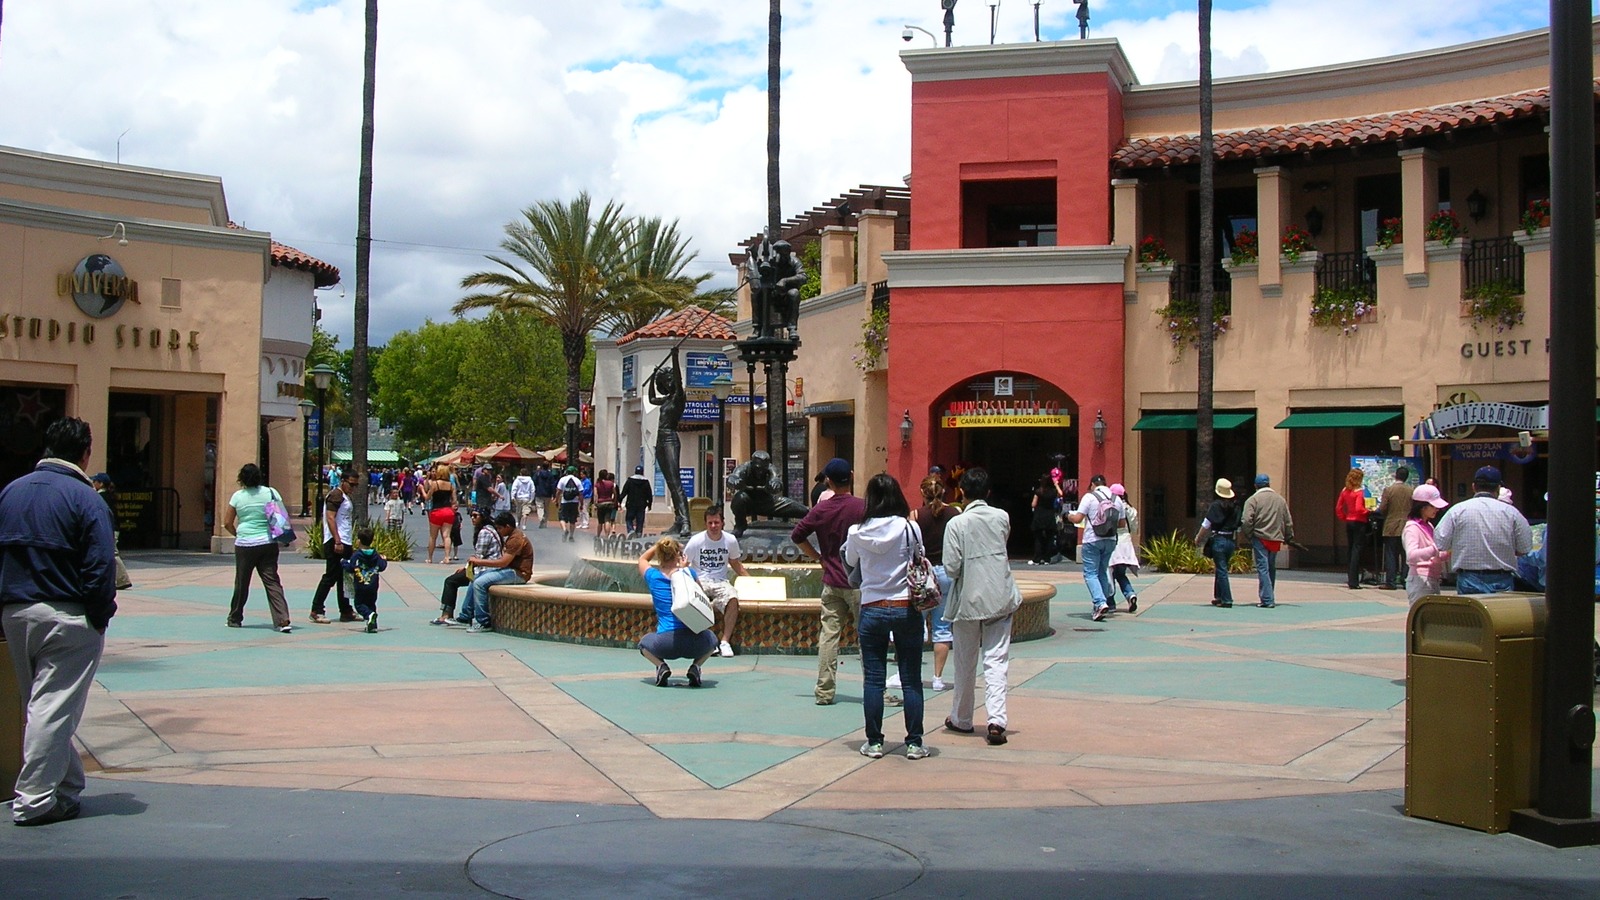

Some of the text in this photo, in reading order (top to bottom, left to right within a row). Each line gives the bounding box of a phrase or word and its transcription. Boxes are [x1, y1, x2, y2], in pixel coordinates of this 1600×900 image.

[56, 271, 142, 305] UNIVERSAL
[0, 312, 201, 352] STUDIO STORE
[1460, 339, 1532, 359] GUEST
[950, 400, 1009, 415] UNIVERSAL
[1014, 400, 1040, 415] FILM
[1456, 407, 1534, 427] INFORMATION
[1461, 450, 1497, 458] YOUR DAY
[1472, 443, 1483, 451] TO
[1484, 443, 1502, 451] PLAN
[593, 536, 654, 559] UNIVERS
[699, 547, 717, 556] Laps,
[699, 554, 724, 562] Poles &
